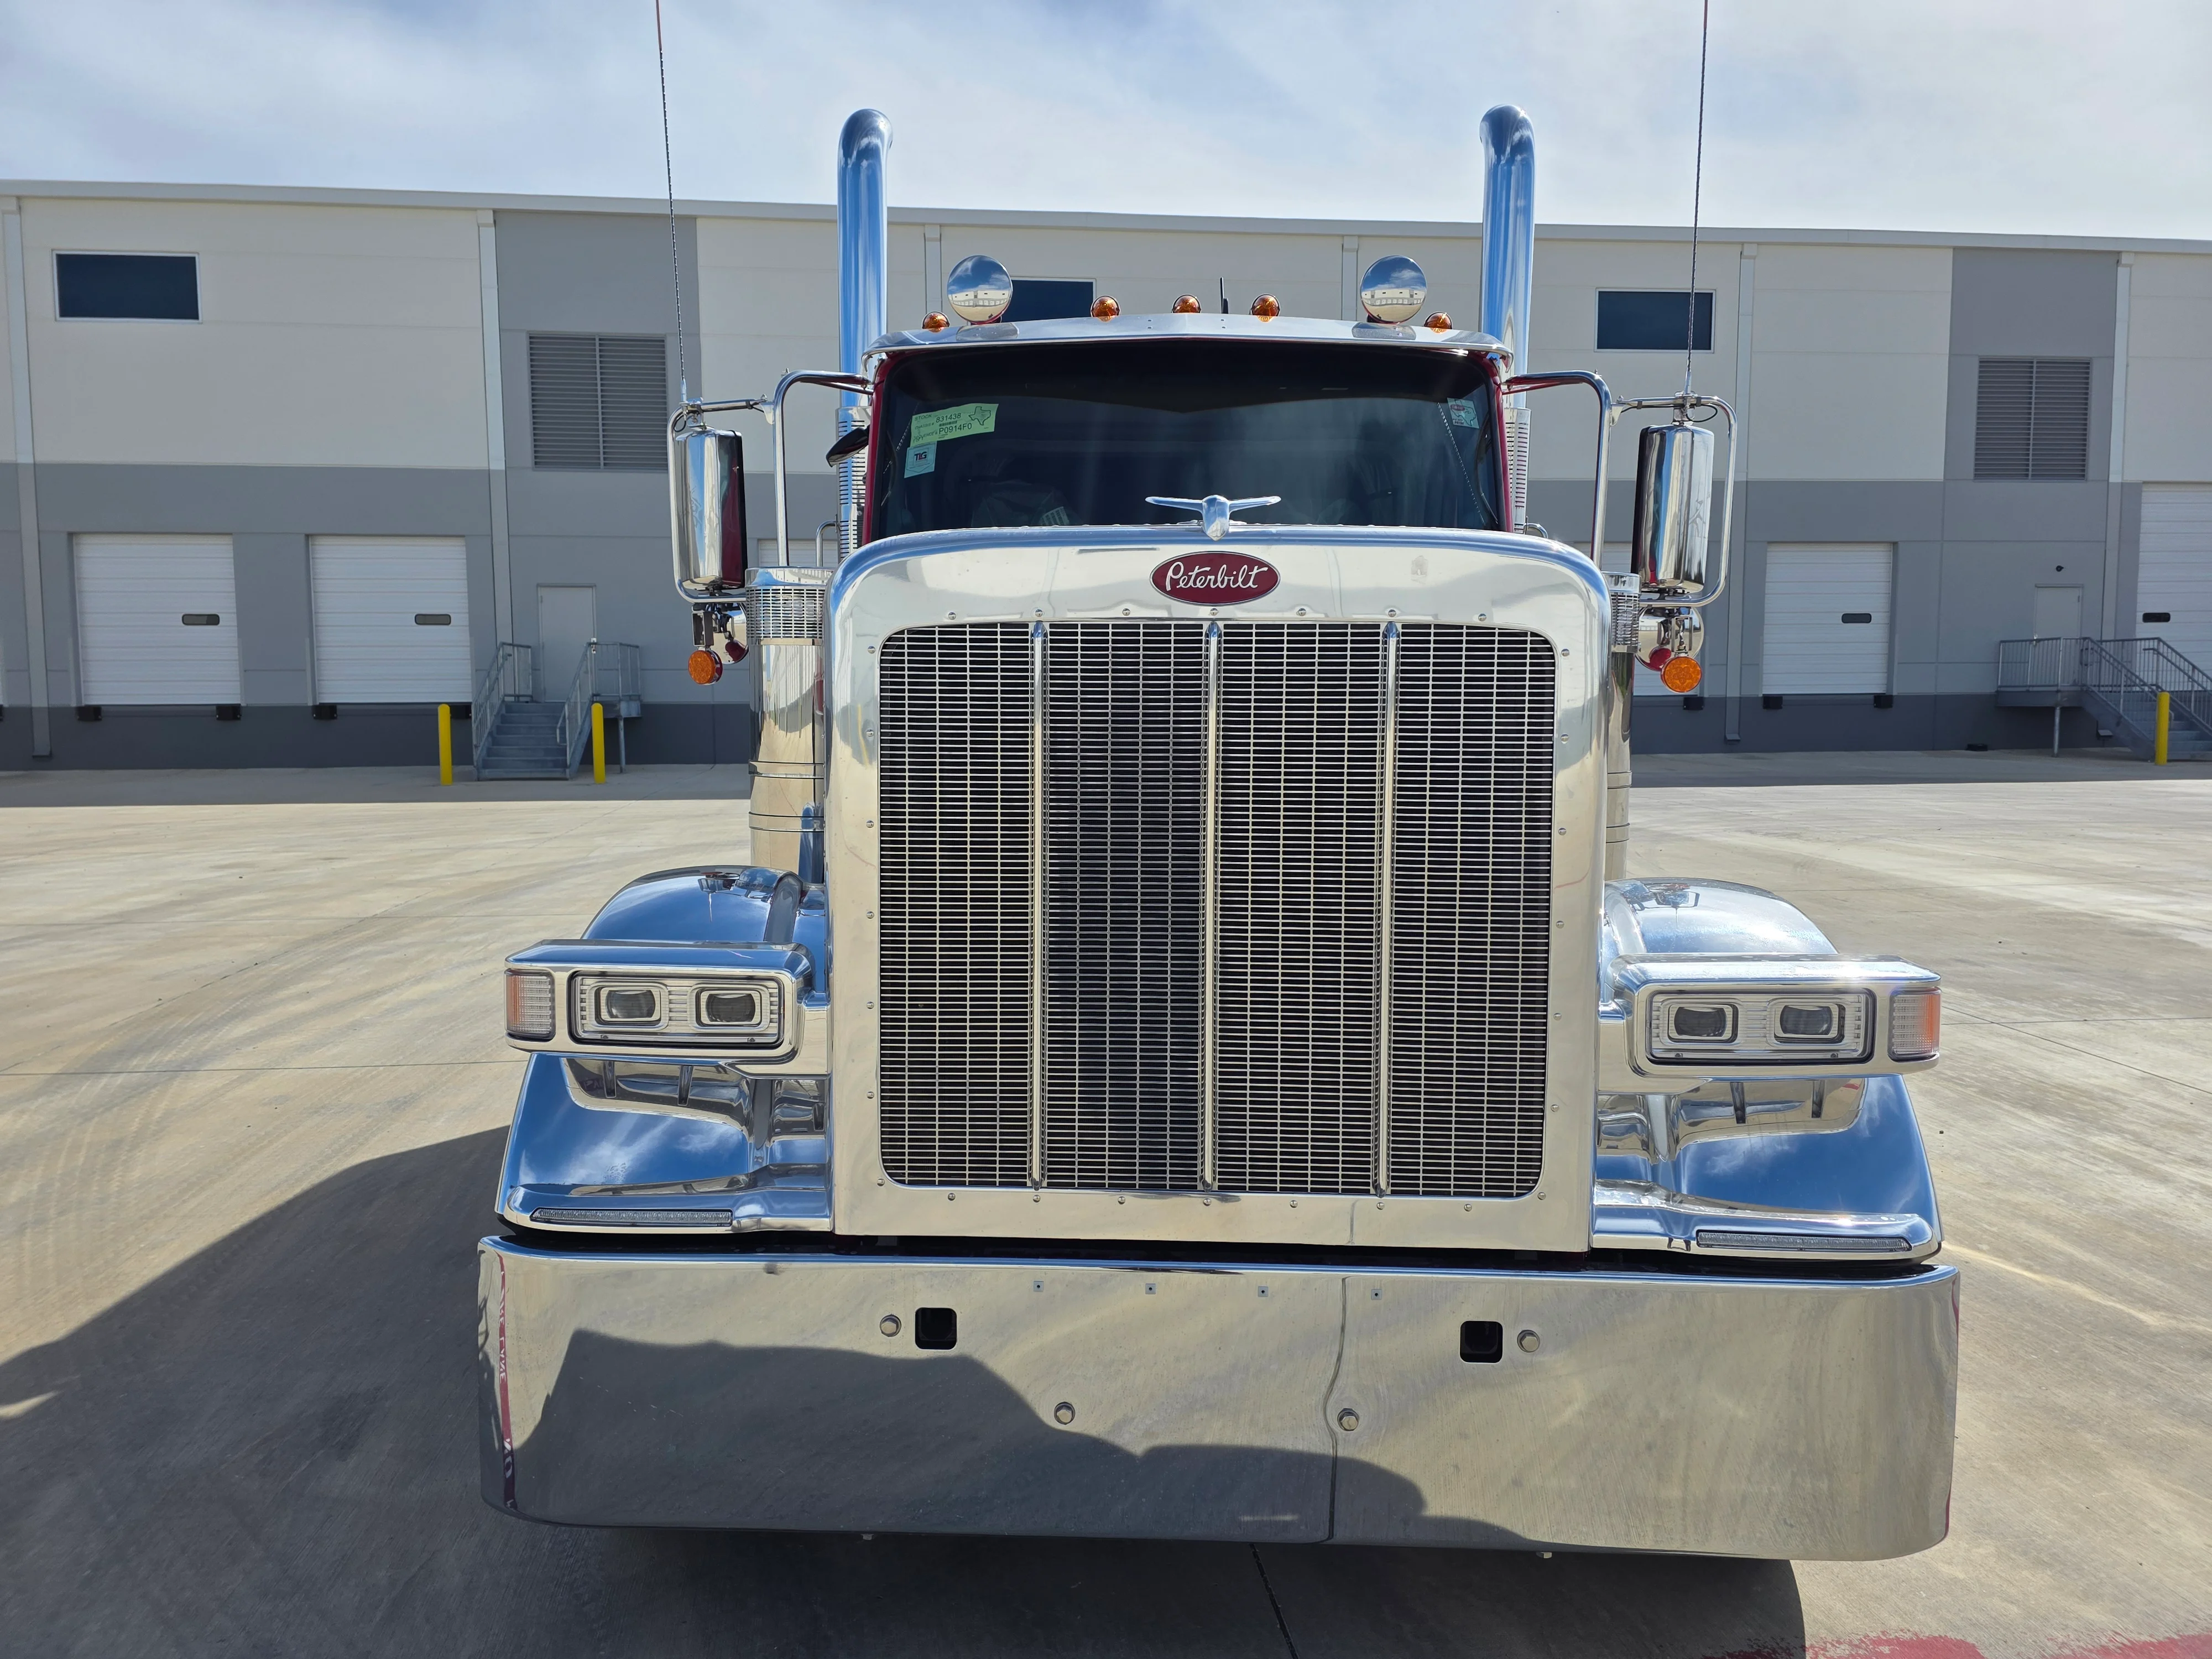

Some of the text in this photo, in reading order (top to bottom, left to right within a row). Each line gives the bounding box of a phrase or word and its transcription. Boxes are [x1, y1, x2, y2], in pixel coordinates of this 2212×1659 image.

[936, 413, 961, 423] 831438
[939, 422, 972, 434] P0914F0
[914, 451, 927, 461] TLG
[1165, 561, 1269, 591] Peterbilt
